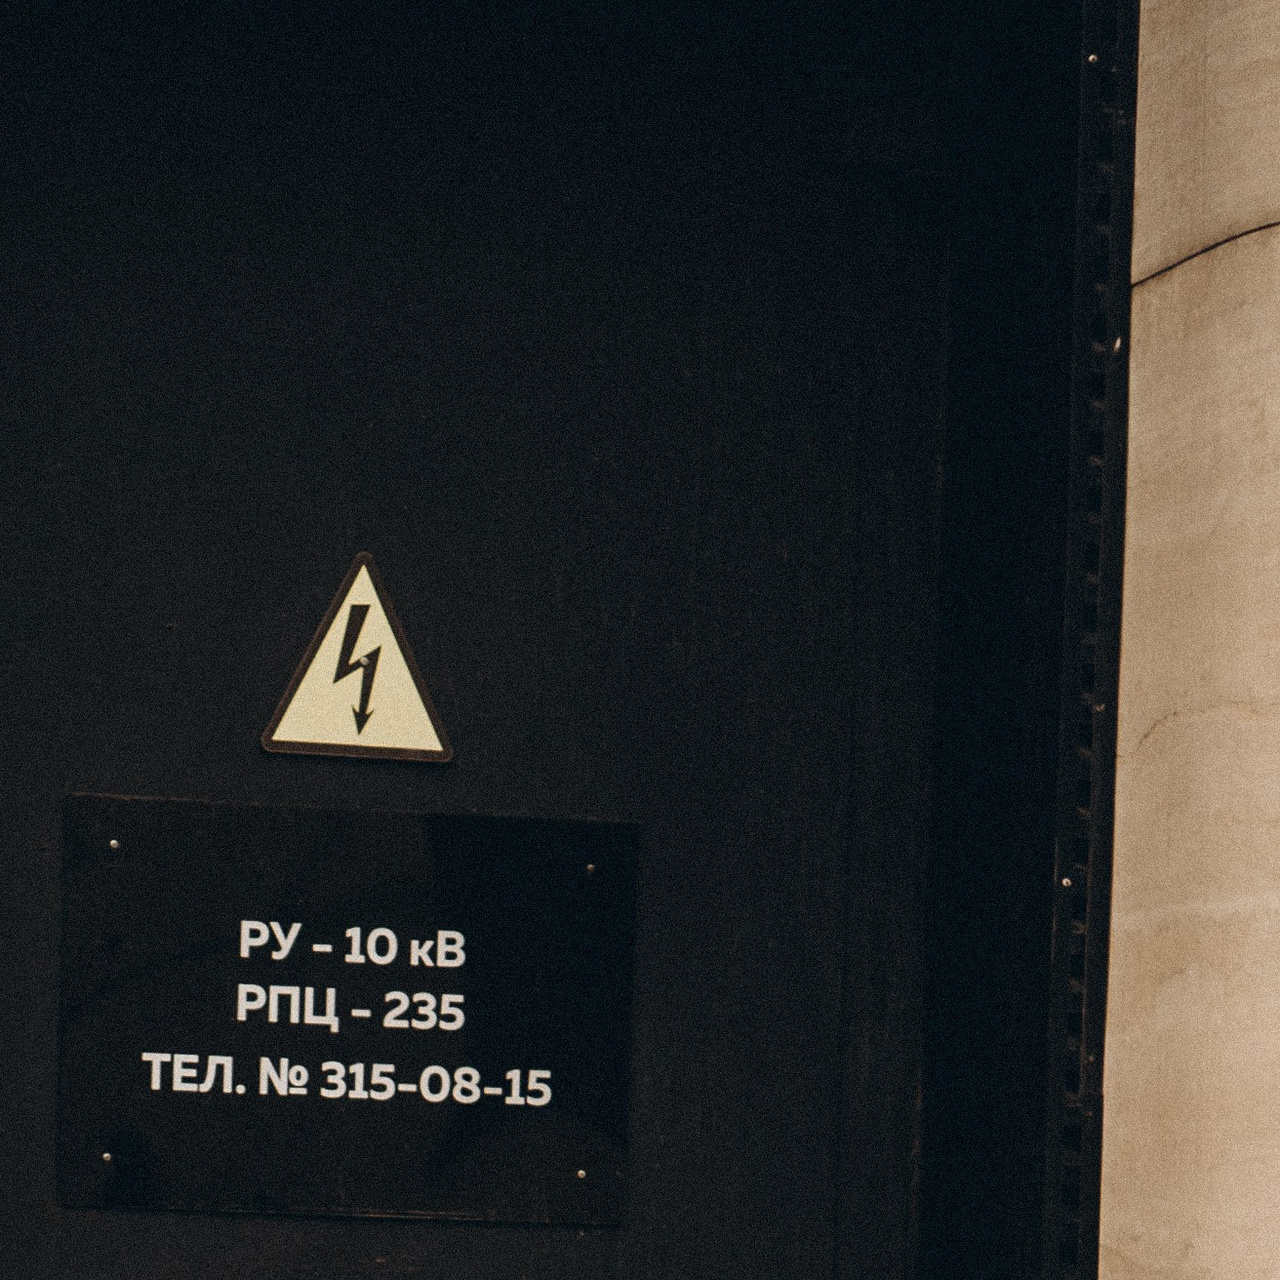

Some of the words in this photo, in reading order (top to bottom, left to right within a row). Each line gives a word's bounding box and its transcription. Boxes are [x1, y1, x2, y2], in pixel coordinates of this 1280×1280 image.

[239, 919, 303, 961] РУ
[344, 926, 399, 965] 10
[410, 929, 466, 968] кВ
[236, 983, 340, 1033] РПЦ
[382, 990, 466, 1031] 235
[141, 1051, 246, 1095] ТЕЛ.
[259, 1056, 309, 1096] №
[320, 1060, 553, 1107] 315-08-15
